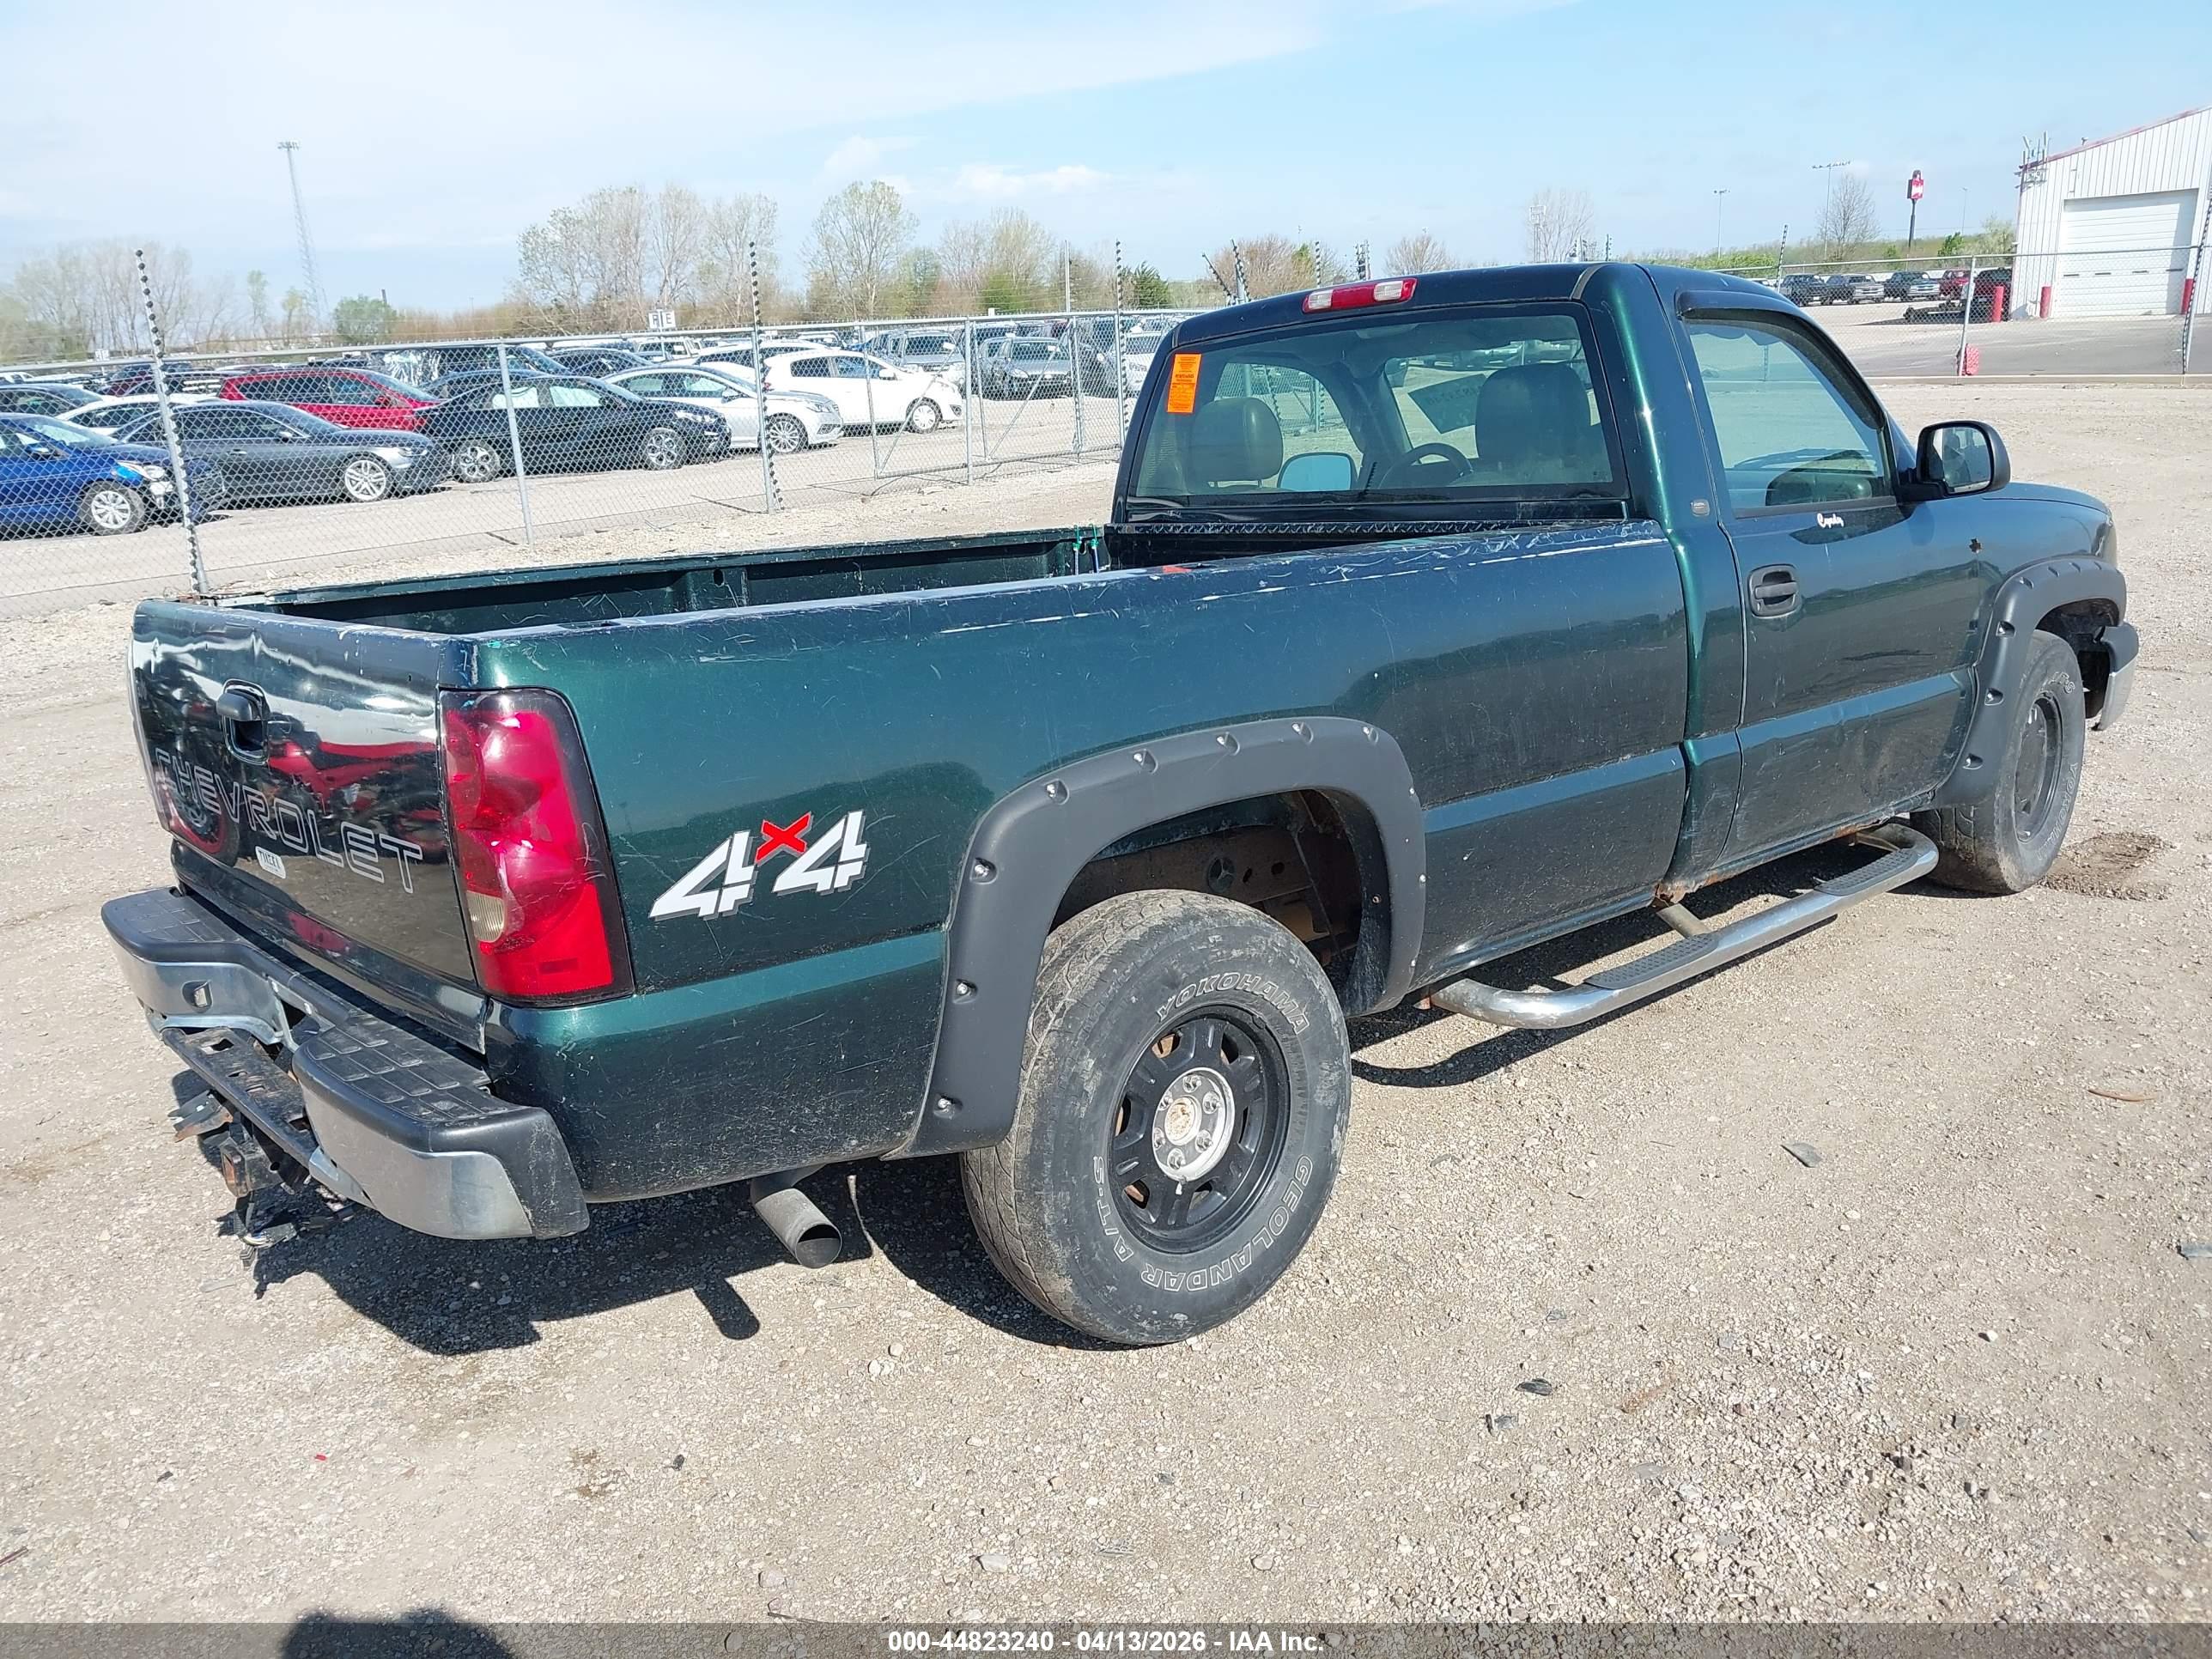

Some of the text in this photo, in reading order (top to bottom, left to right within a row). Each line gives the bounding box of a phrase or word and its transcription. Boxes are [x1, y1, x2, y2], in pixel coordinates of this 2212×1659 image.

[155, 747, 423, 894] CHEVROLET
[1156, 972, 1310, 1035] YOKOHAMA
[1140, 1154, 1314, 1292] GEOLANDAR
